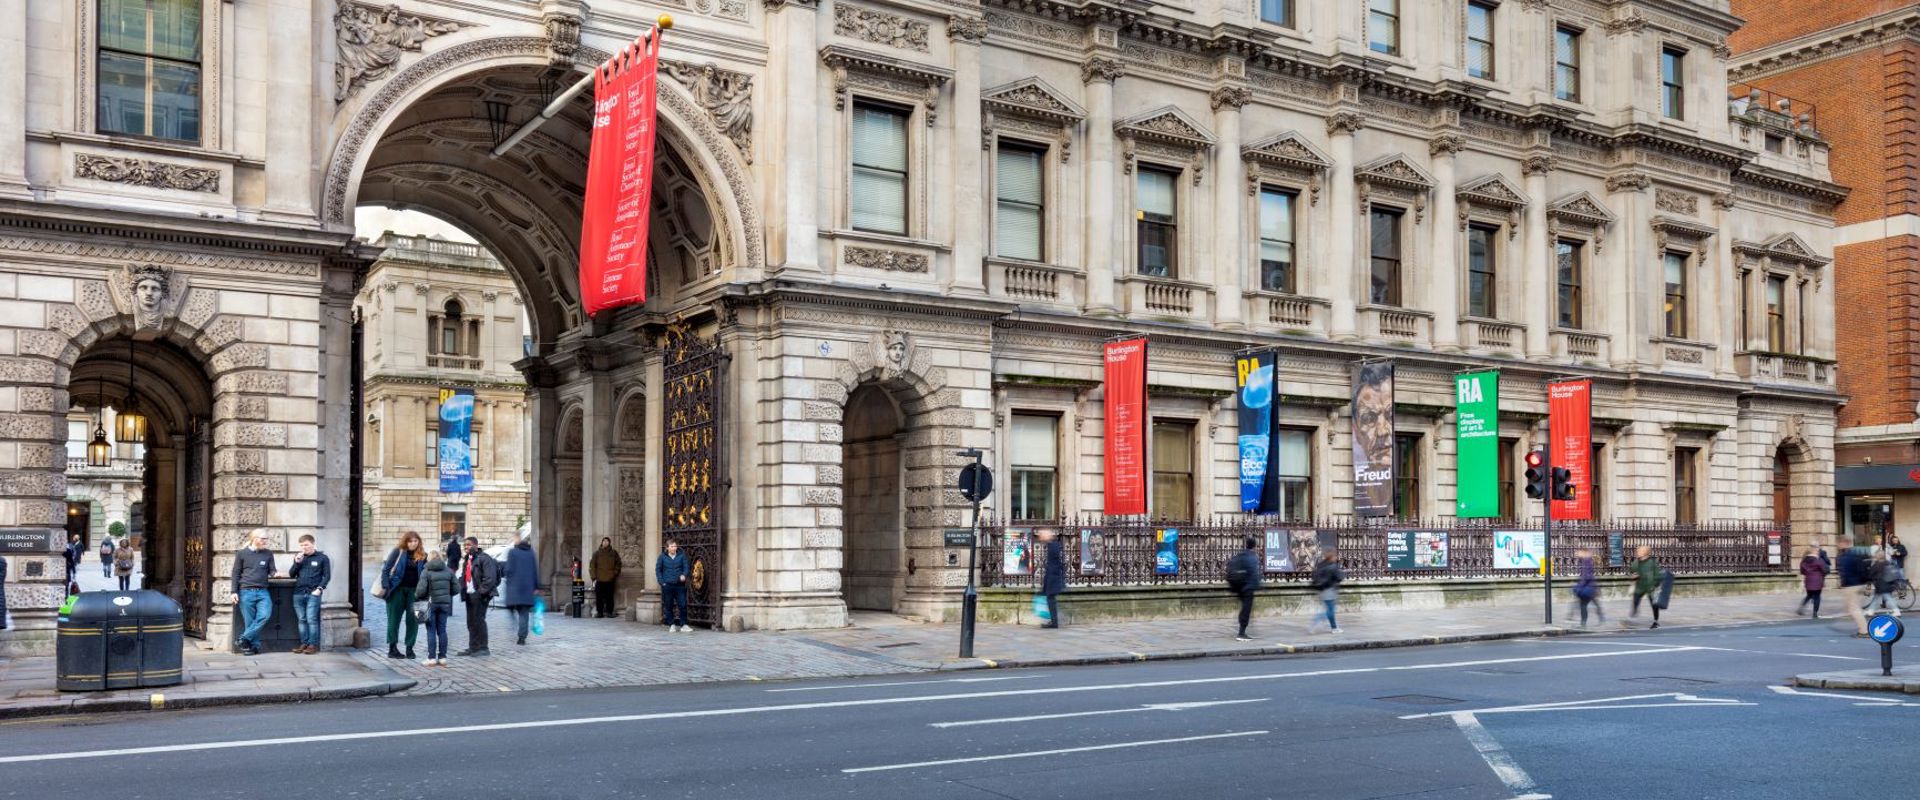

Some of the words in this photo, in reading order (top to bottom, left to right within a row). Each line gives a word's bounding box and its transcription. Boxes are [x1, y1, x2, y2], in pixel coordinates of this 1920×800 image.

[1107, 345, 1140, 355] Burlington
[1107, 354, 1127, 362] House
[1458, 377, 1484, 404] RA
[1551, 385, 1585, 393] Burlington
[1355, 467, 1391, 481] Freud
[1266, 532, 1280, 549] RA
[1266, 557, 1287, 567] Freud
